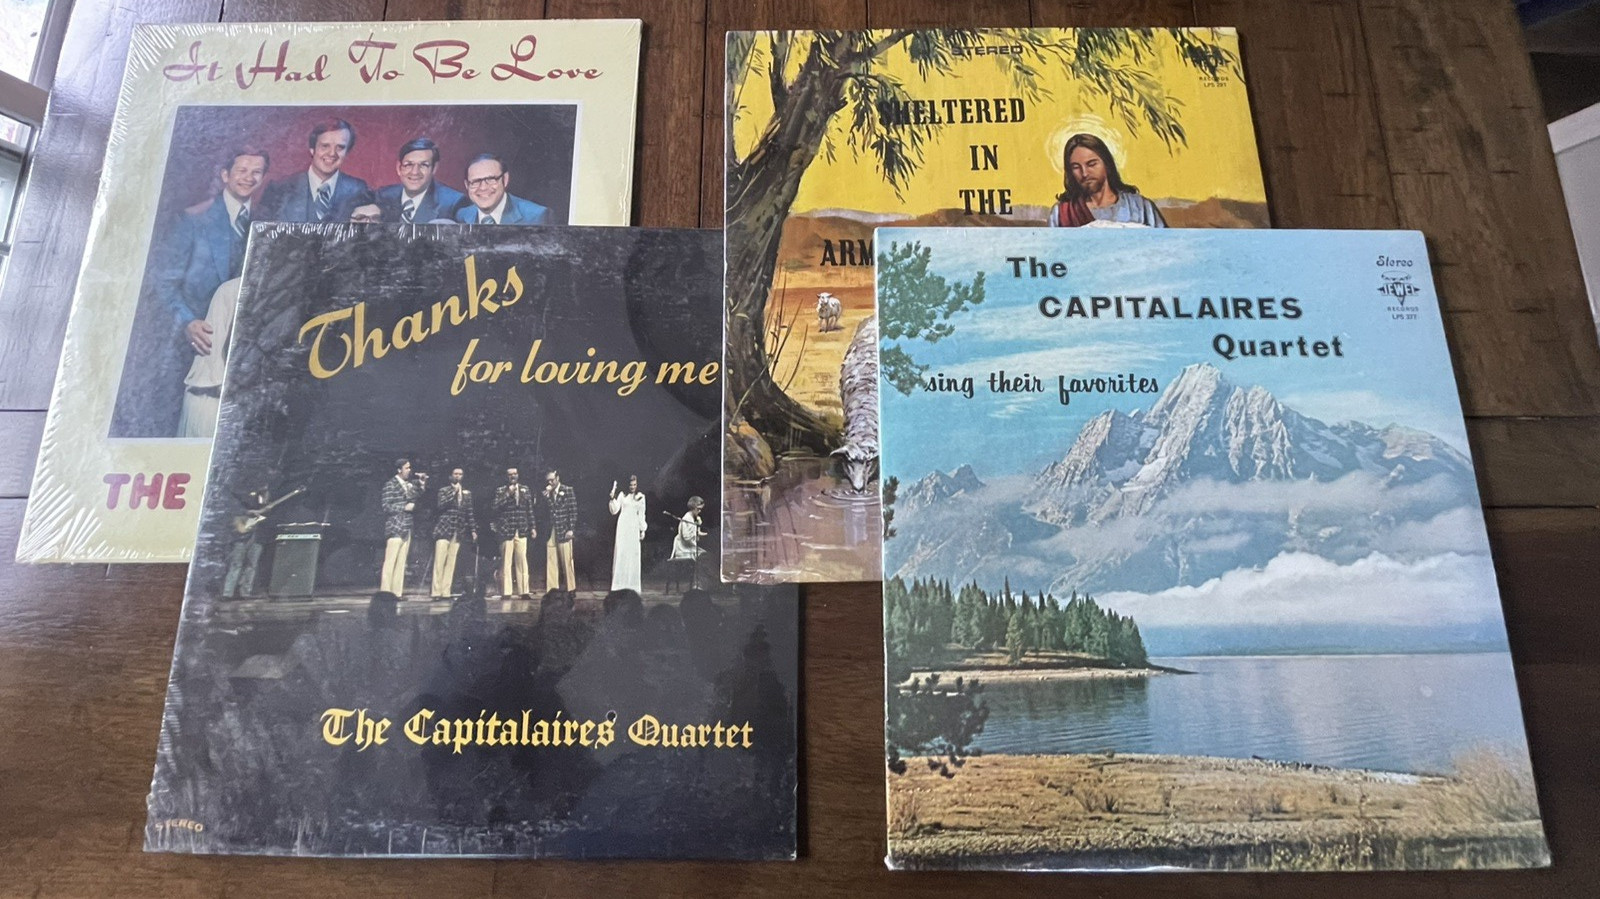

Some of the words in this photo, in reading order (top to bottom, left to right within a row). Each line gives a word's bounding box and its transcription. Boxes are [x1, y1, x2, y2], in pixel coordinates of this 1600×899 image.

[163, 40, 222, 82] It
[235, 40, 331, 90] Had
[348, 32, 404, 83] To
[413, 40, 481, 84] Be
[490, 34, 604, 82] Love
[952, 45, 1023, 56] STEREO
[879, 98, 1025, 125] SHELTERED
[970, 144, 998, 171] IN
[959, 188, 1013, 216] THE
[1006, 256, 1068, 279] The
[1376, 255, 1414, 267] Stereo
[298, 254, 524, 379] Thanks
[1038, 296, 1304, 320] CAPITALAIRES
[1212, 333, 1344, 360] Quartet
[450, 338, 511, 396] for
[520, 339, 646, 397] loving
[655, 360, 719, 385] me
[924, 373, 975, 399] sing
[987, 370, 1044, 394] their
[1058, 371, 1160, 406] favorites
[103, 472, 191, 510] THE
[320, 707, 391, 752] The
[404, 708, 616, 754] Capitalaires
[627, 713, 754, 749] Quartet
